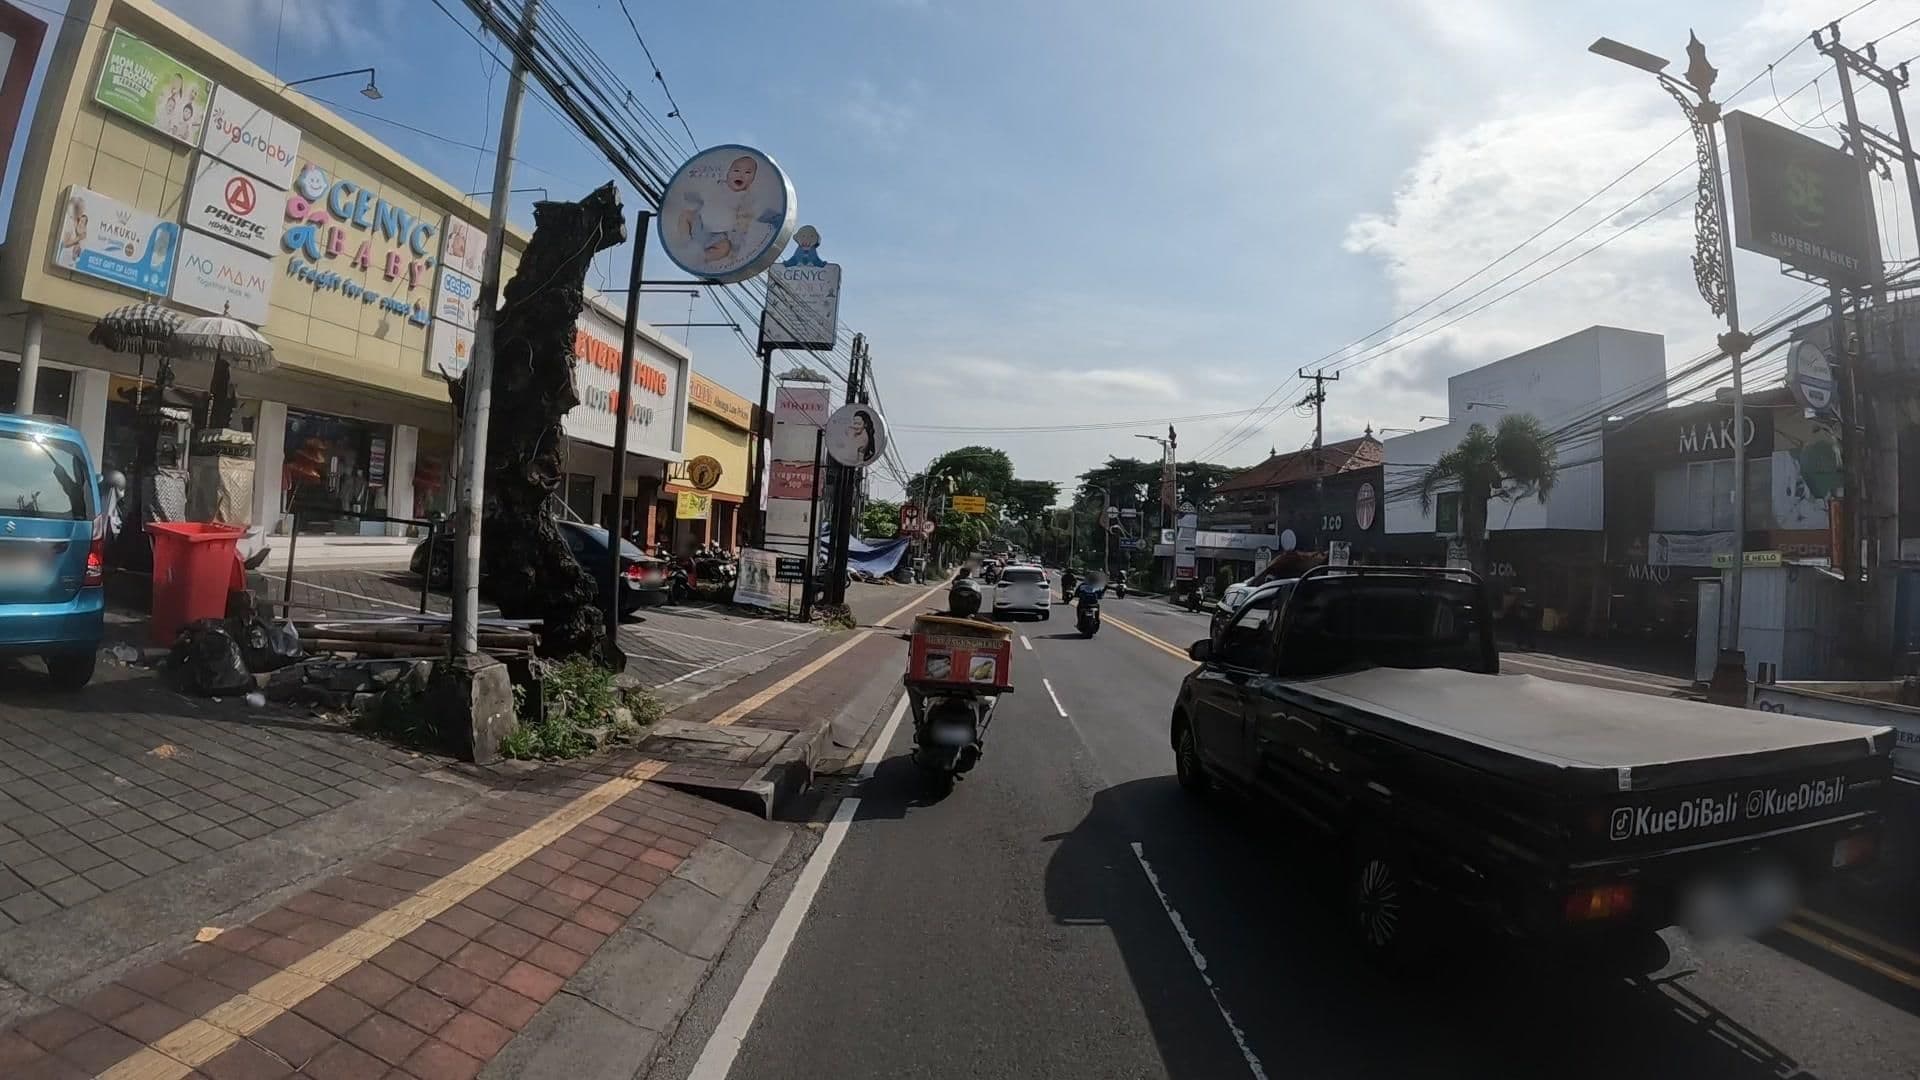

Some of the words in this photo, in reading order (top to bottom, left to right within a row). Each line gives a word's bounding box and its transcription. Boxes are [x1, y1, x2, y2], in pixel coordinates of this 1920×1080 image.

[215, 116, 294, 167] sugarbaby
[99, 221, 138, 242] MAKUKU
[204, 204, 266, 236] PACIFIC
[328, 180, 437, 257] GENYC
[326, 226, 427, 291] BABY
[1770, 231, 1860, 270] SUPERMARKET
[783, 269, 826, 281] GENYC
[575, 330, 667, 396] EVERTHING
[1679, 415, 1756, 454] MAKO
[1628, 563, 1671, 585] MAKO
[1634, 792, 1739, 836] KueDiBali
[1763, 776, 1846, 816] KueDiBali
